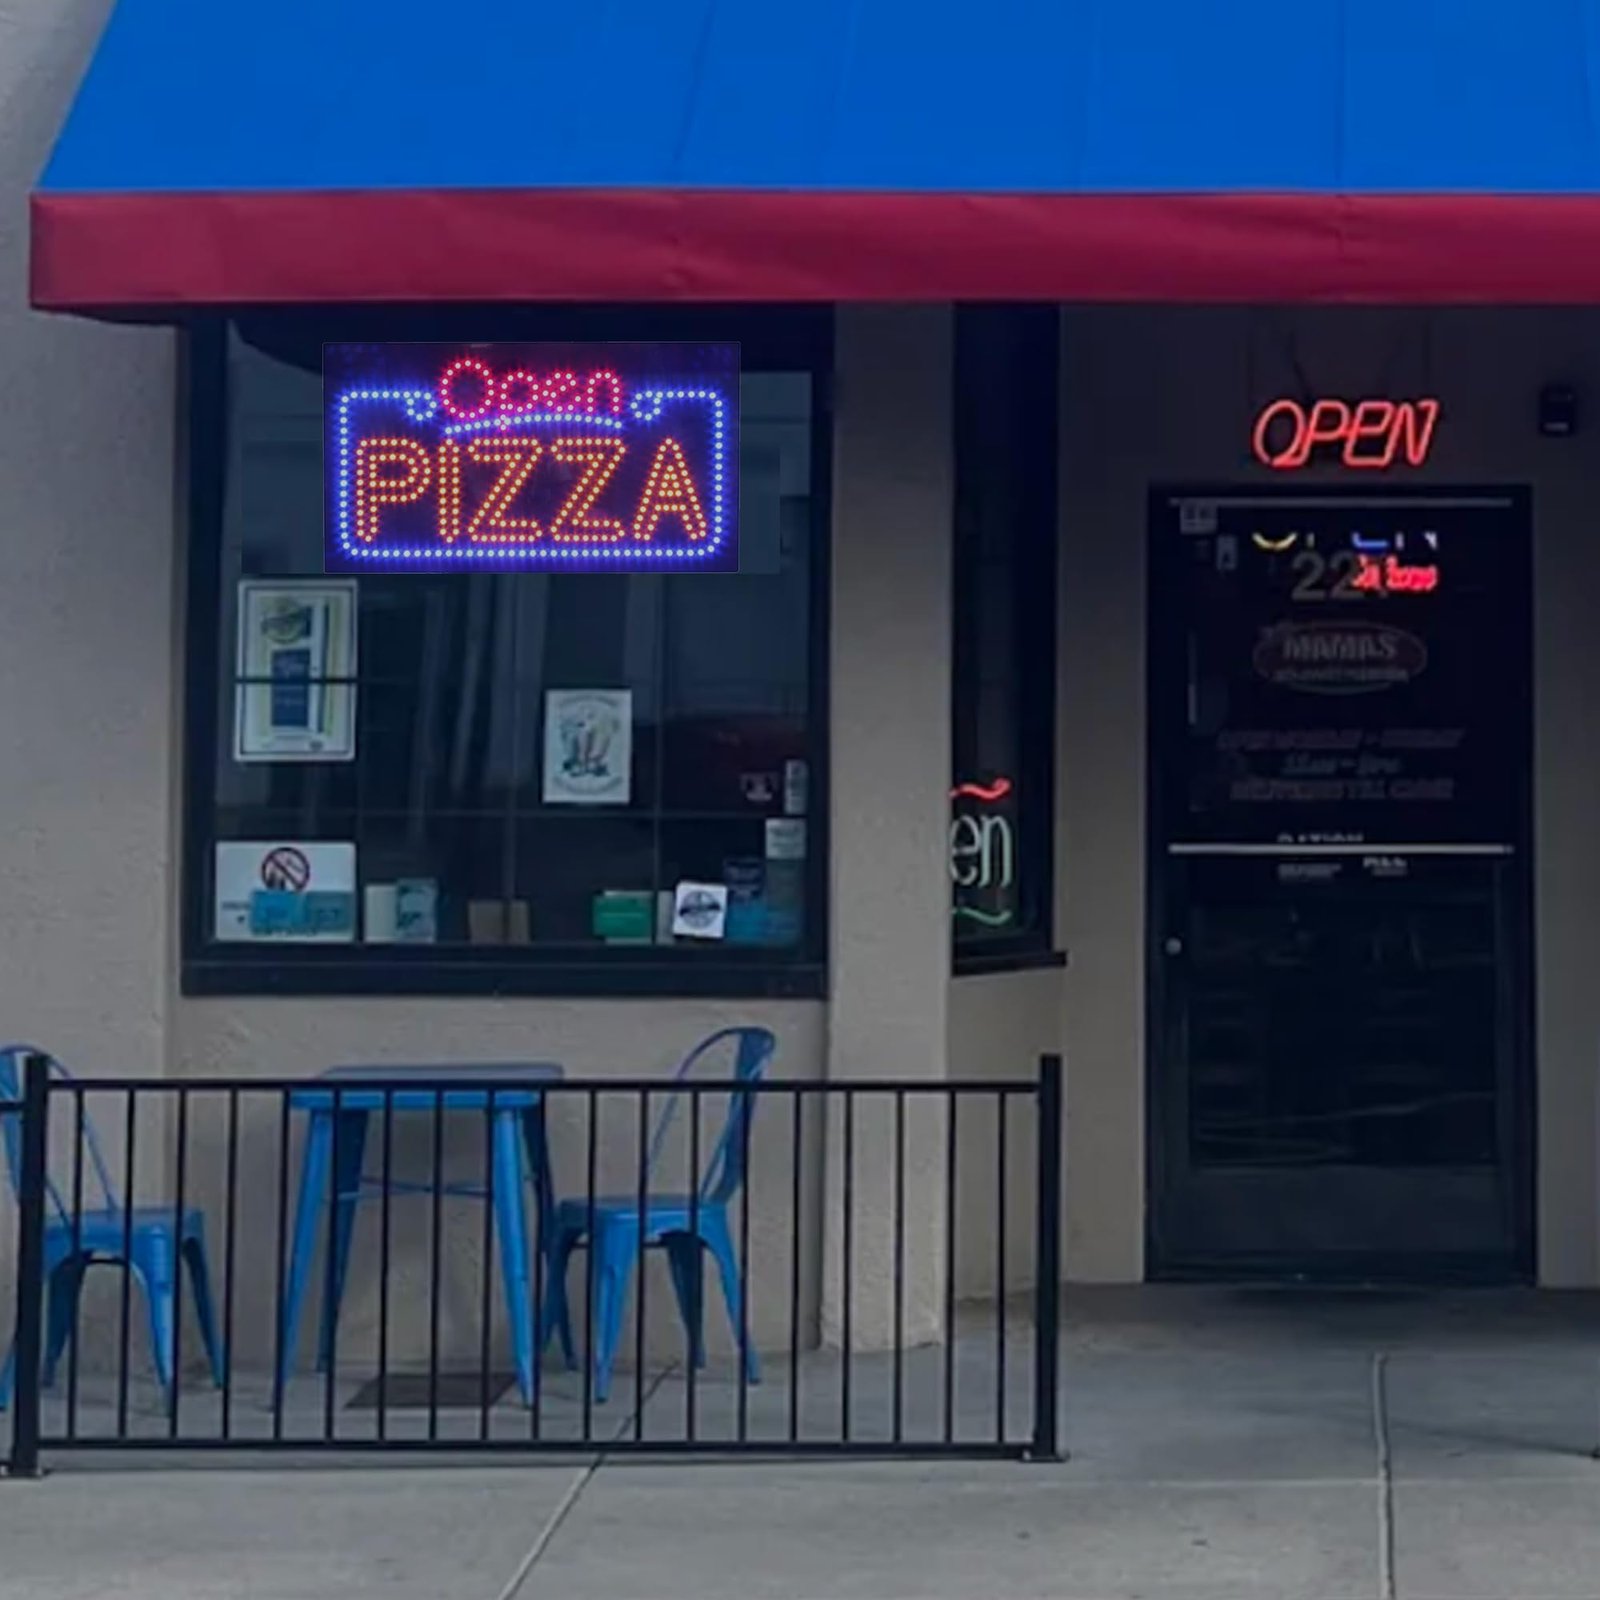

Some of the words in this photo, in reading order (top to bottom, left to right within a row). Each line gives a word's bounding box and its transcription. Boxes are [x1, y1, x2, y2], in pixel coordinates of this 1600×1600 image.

[439, 358, 622, 433] Open
[1253, 399, 1440, 470] OPEN
[355, 437, 709, 543] PIZZA
